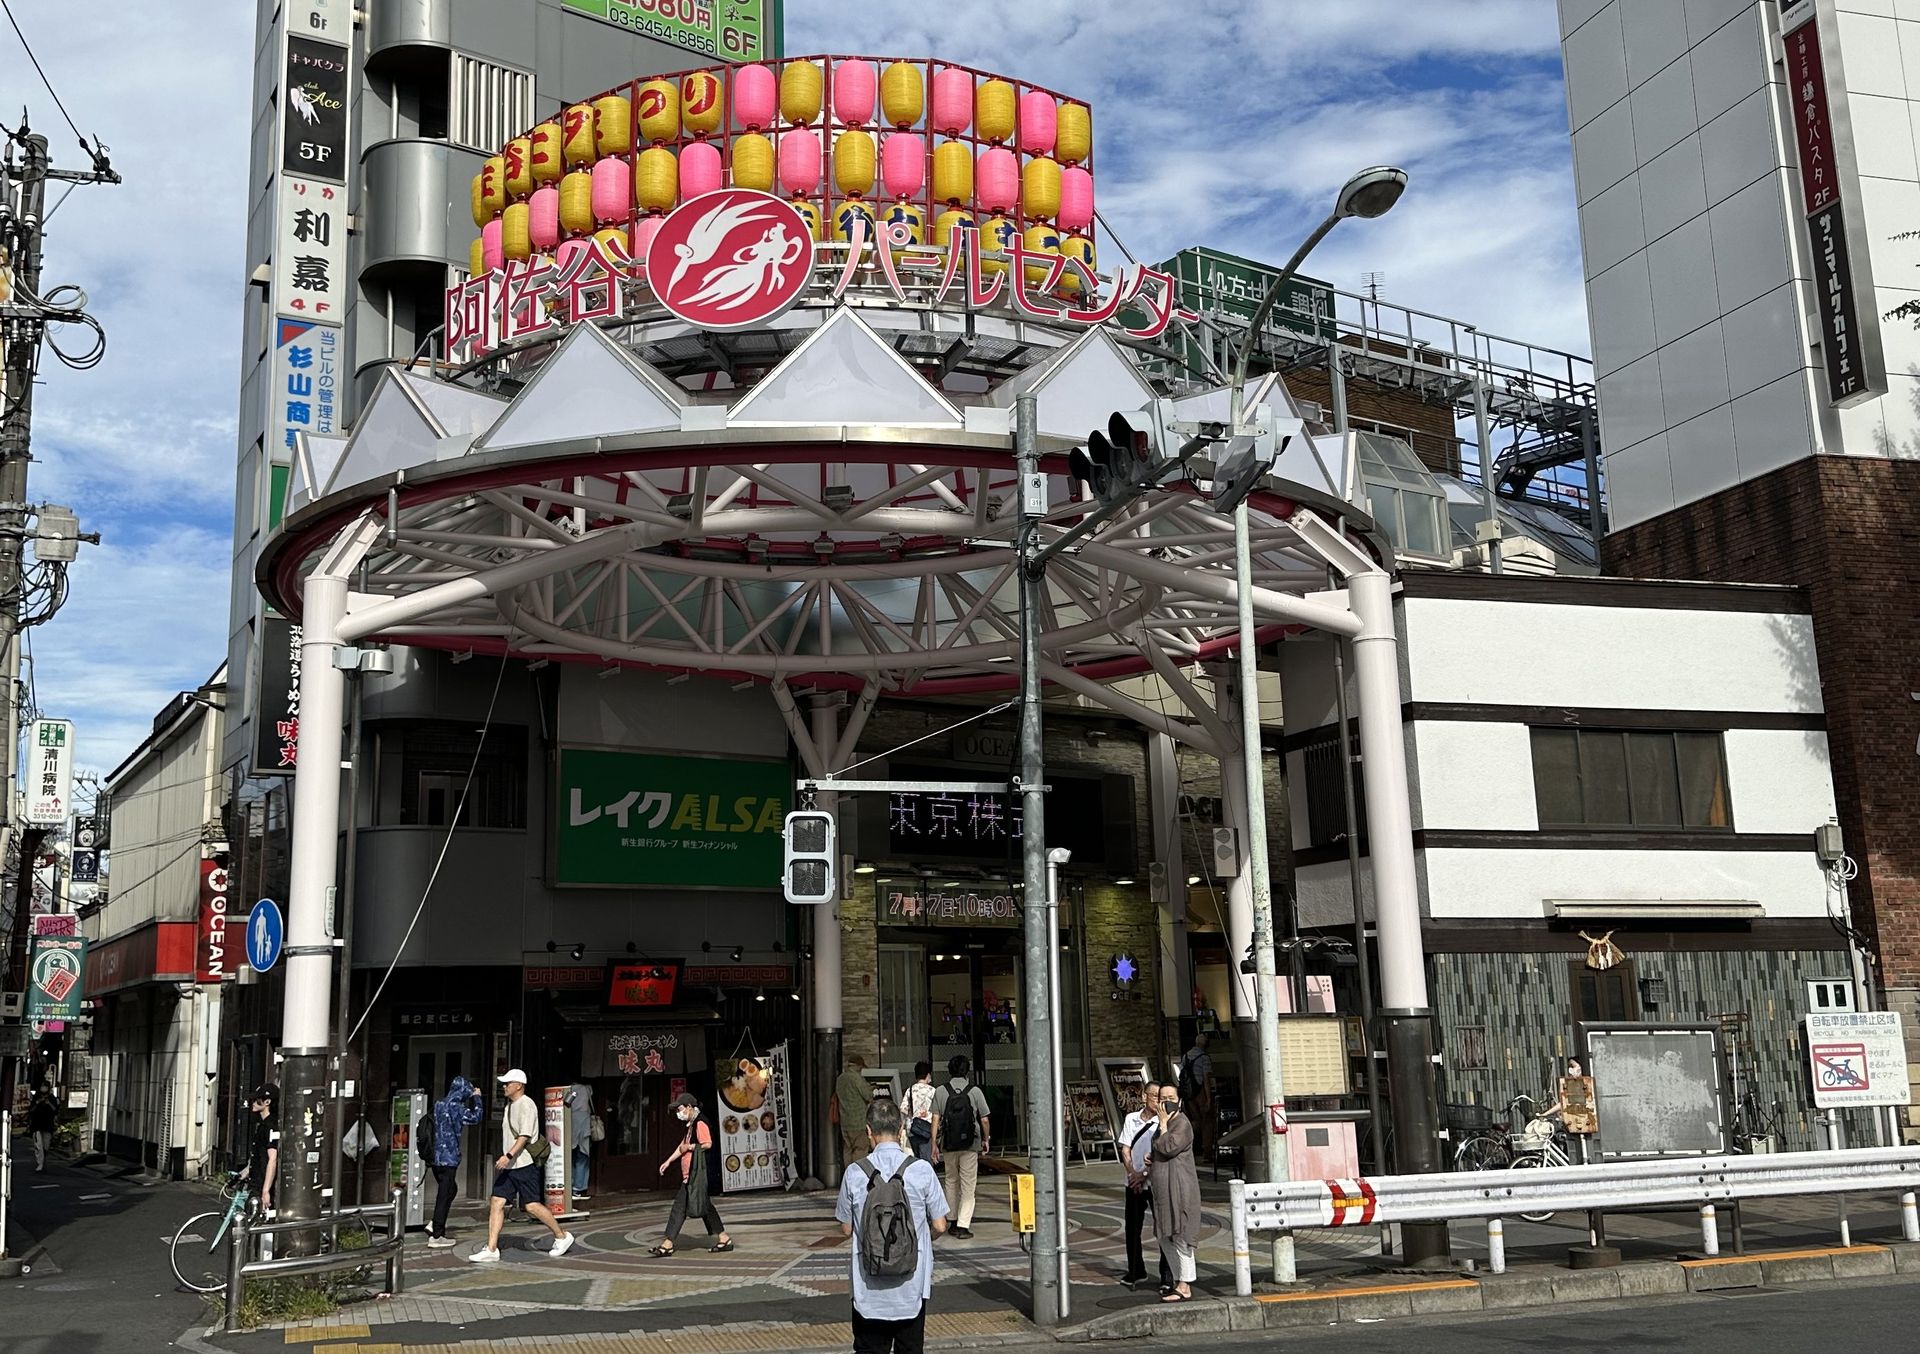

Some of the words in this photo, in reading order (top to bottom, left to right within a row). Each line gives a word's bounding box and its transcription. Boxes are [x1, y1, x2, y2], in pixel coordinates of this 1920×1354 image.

[310, 12, 328, 30] 6F
[609, 8, 715, 53] 03-6454-6856
[723, 27, 757, 56] 6F
[300, 142, 332, 163] 5F
[1814, 187, 1831, 206] 2F
[292, 207, 331, 293] 利嘉
[833, 218, 1199, 338] パールセンター
[290, 298, 331, 314] 4F
[446, 238, 632, 362] 阿佐谷
[1819, 213, 1850, 375] サンマルクカフェ
[317, 331, 335, 433] 当ビルの管理は
[1839, 376, 1856, 394] 1F
[42, 749, 58, 796] 清川病院
[621, 837, 678, 848] 新生銀行グループ
[682, 840, 738, 851] 新生フィナンシャル
[208, 897, 228, 976] OCEAN
[1812, 1014, 1896, 1027] 自転車放置禁止区域
[618, 1049, 665, 1074] 味丸
